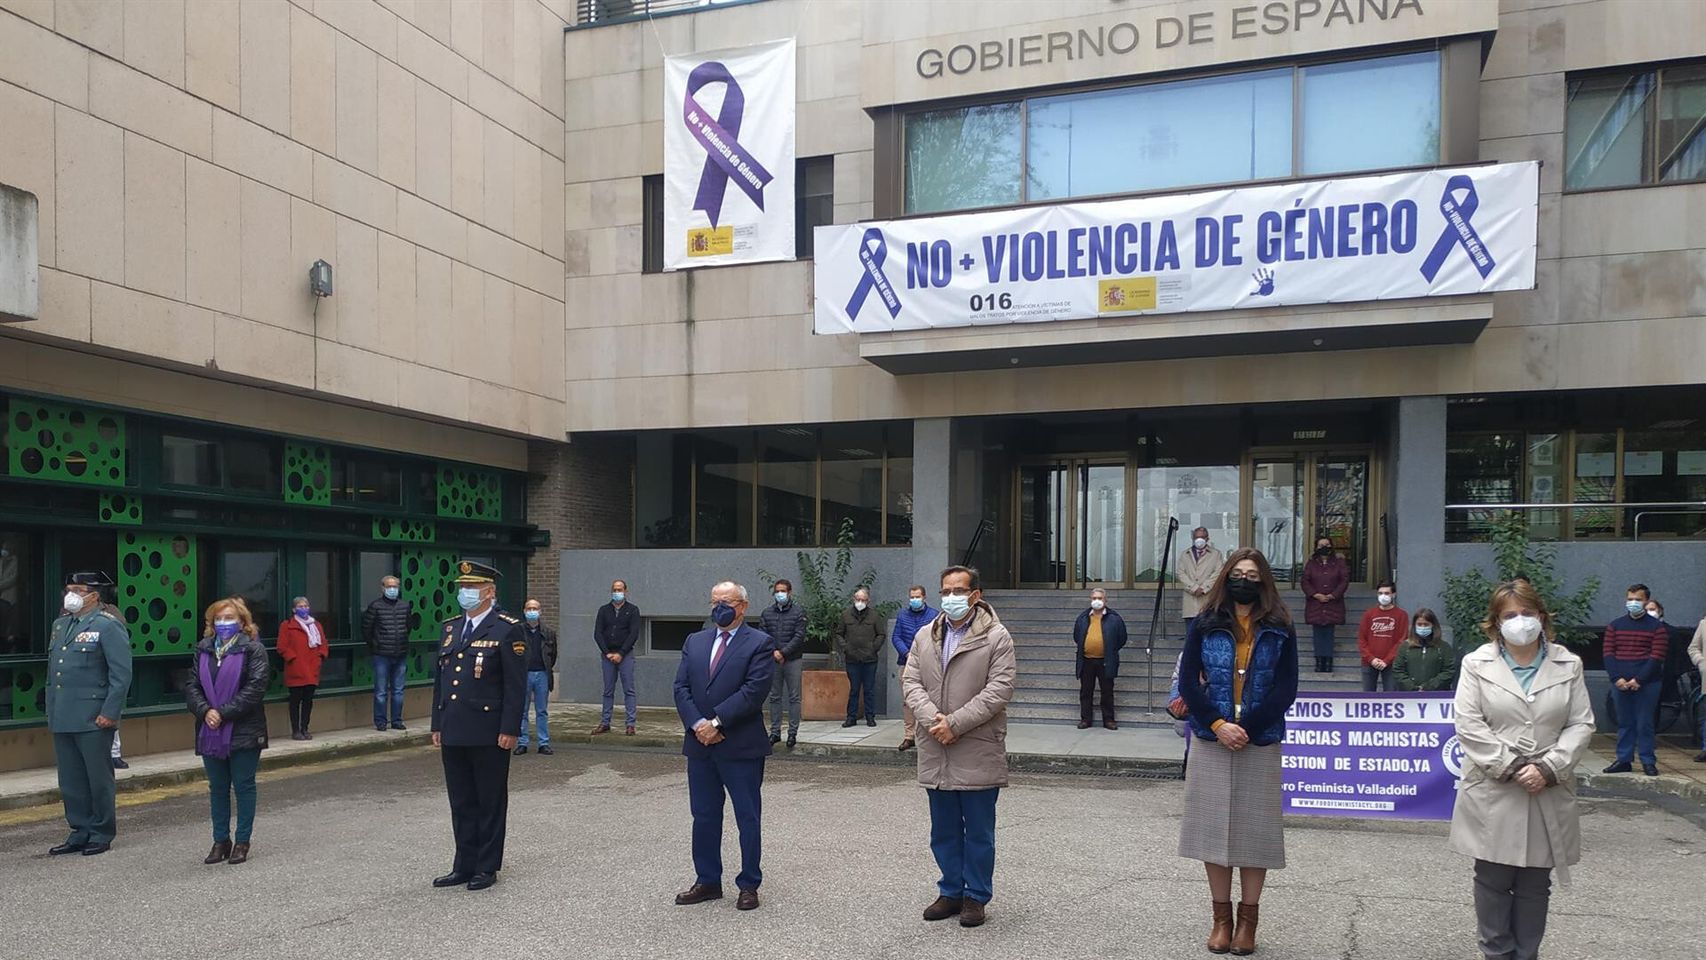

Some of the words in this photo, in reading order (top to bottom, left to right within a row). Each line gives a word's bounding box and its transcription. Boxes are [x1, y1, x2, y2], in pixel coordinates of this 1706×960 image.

[916, 22, 1140, 79] GOBIERNO
[1155, 12, 1214, 49] DE
[687, 111, 700, 125] No
[701, 124, 733, 159] Violencia
[729, 154, 741, 167] de
[737, 162, 763, 190] Género
[1449, 210, 1473, 240] VIOLENCIA
[907, 239, 952, 289] NO
[959, 254, 975, 270] +
[982, 220, 1180, 283] VIOLENCIA
[1195, 214, 1243, 268] DE
[1257, 198, 1418, 264] GÉNERO
[970, 292, 1012, 312] 016
[1345, 703, 1405, 719] LIBRES
[1417, 703, 1427, 719] Y
[1348, 731, 1440, 748] MACHISTAS
[1281, 755, 1326, 770] ESTION
[1334, 757, 1351, 770] DE
[1281, 783, 1295, 791] ro
[1298, 782, 1354, 794] Feminista
[1357, 784, 1417, 796] Valladolid
